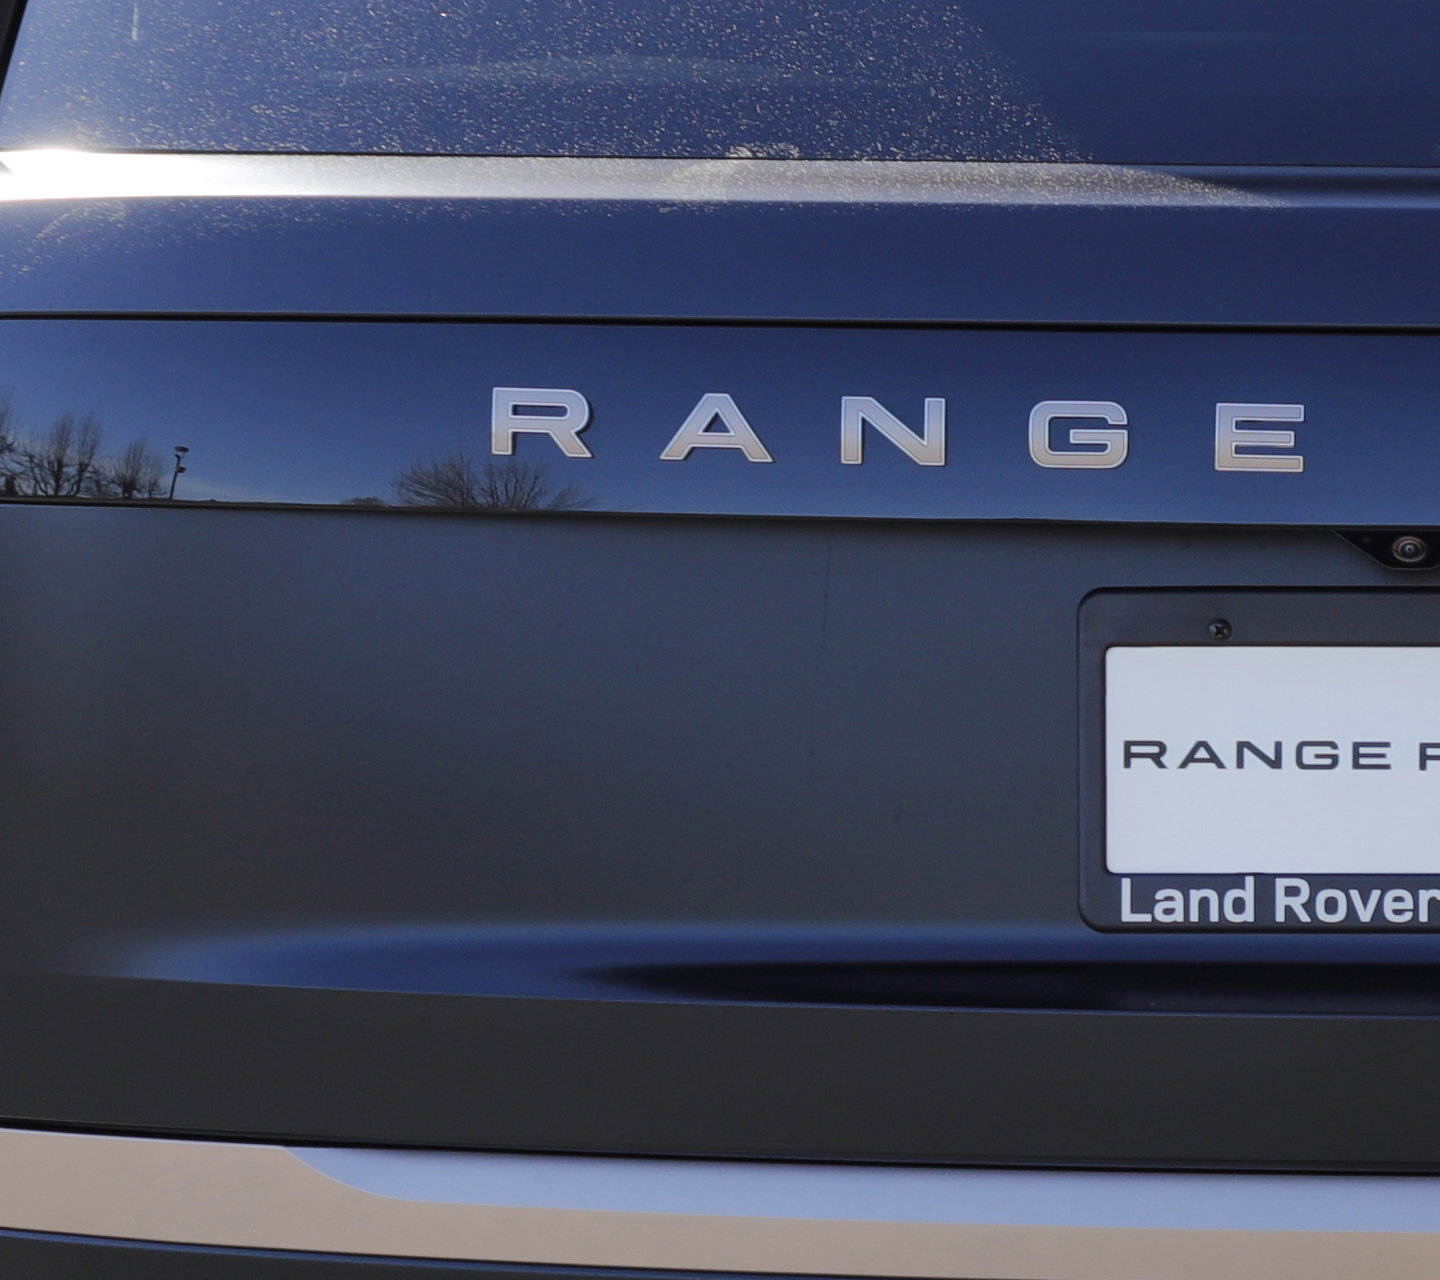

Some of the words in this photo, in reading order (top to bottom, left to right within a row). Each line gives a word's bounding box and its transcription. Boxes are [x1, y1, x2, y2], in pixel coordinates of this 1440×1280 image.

[490, 385, 1307, 473] RANGE
[1122, 739, 1392, 771] RANGE
[1120, 876, 1255, 923] Land
